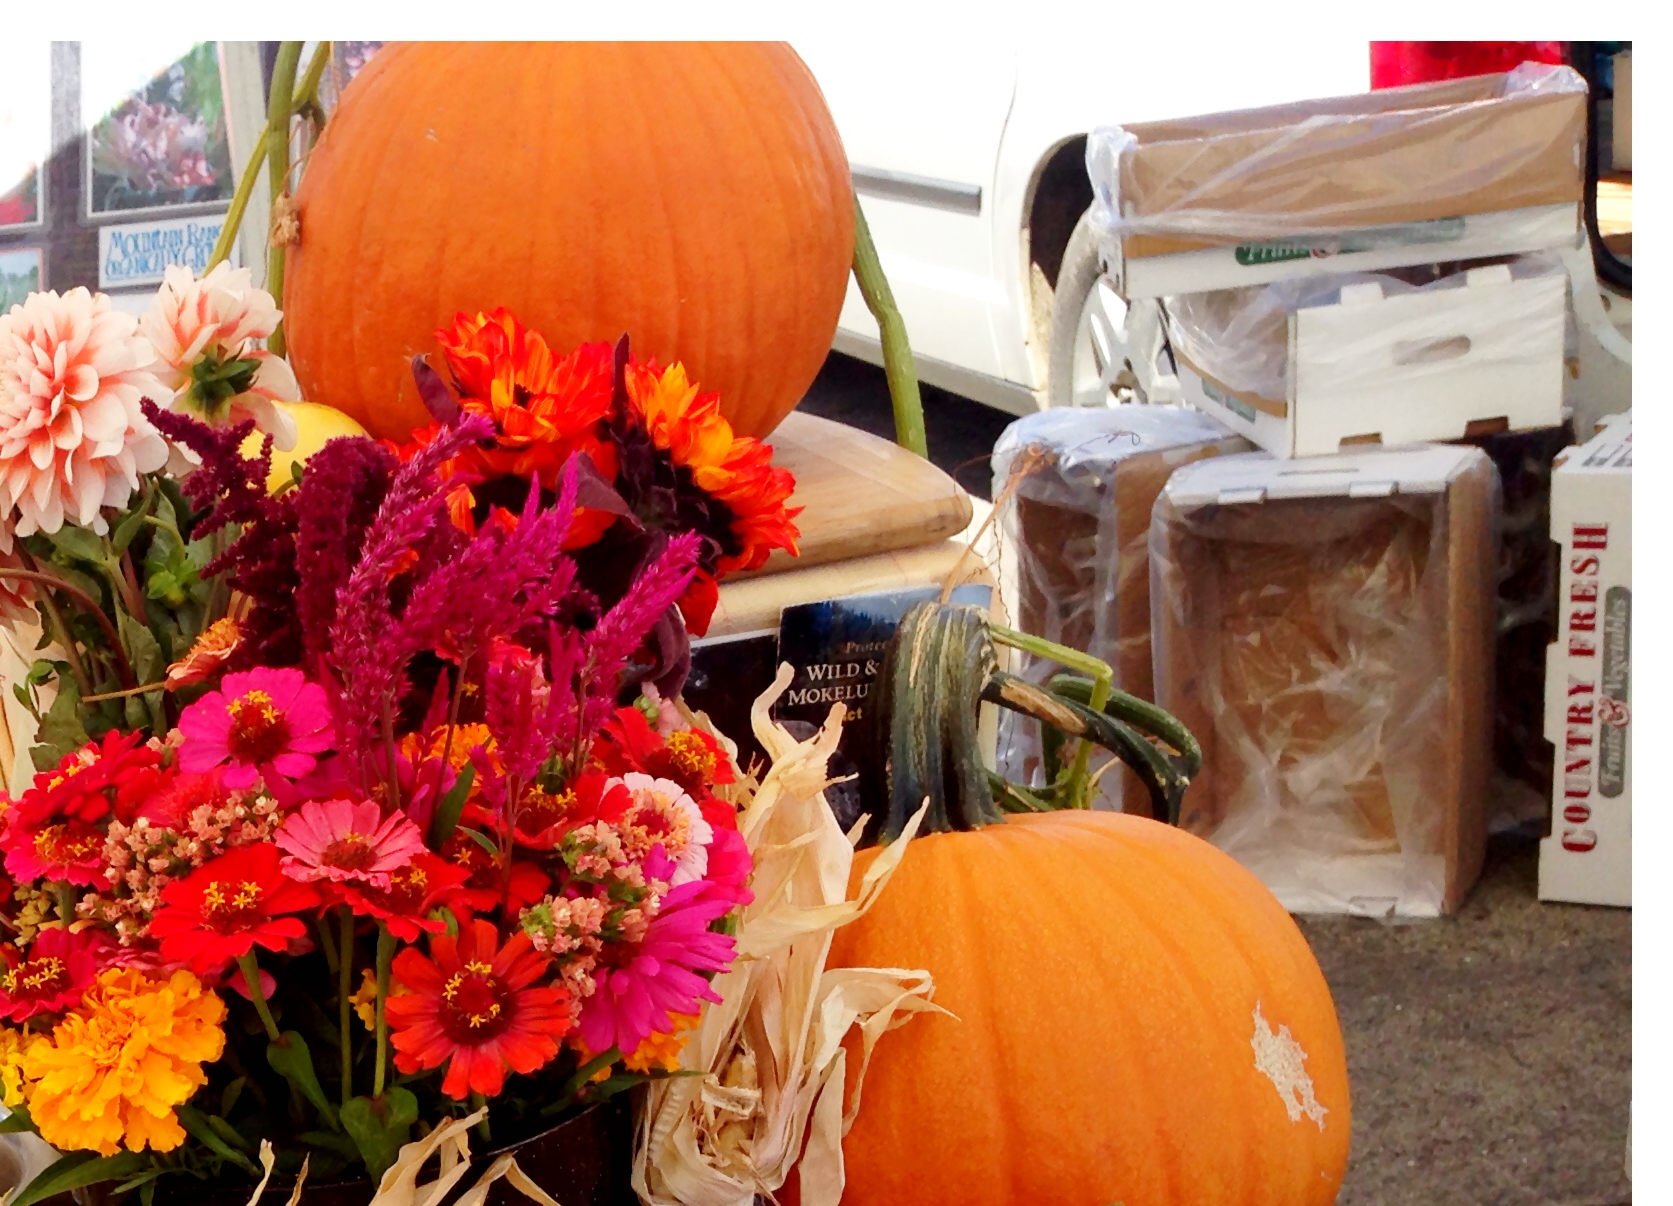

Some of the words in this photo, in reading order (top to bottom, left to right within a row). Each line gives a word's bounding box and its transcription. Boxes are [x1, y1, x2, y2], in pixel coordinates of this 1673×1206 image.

[1568, 521, 1609, 658] FRESH
[787, 683, 874, 706] MOKELU
[806, 662, 861, 682] WILD
[1561, 673, 1598, 853] COUNTRY
